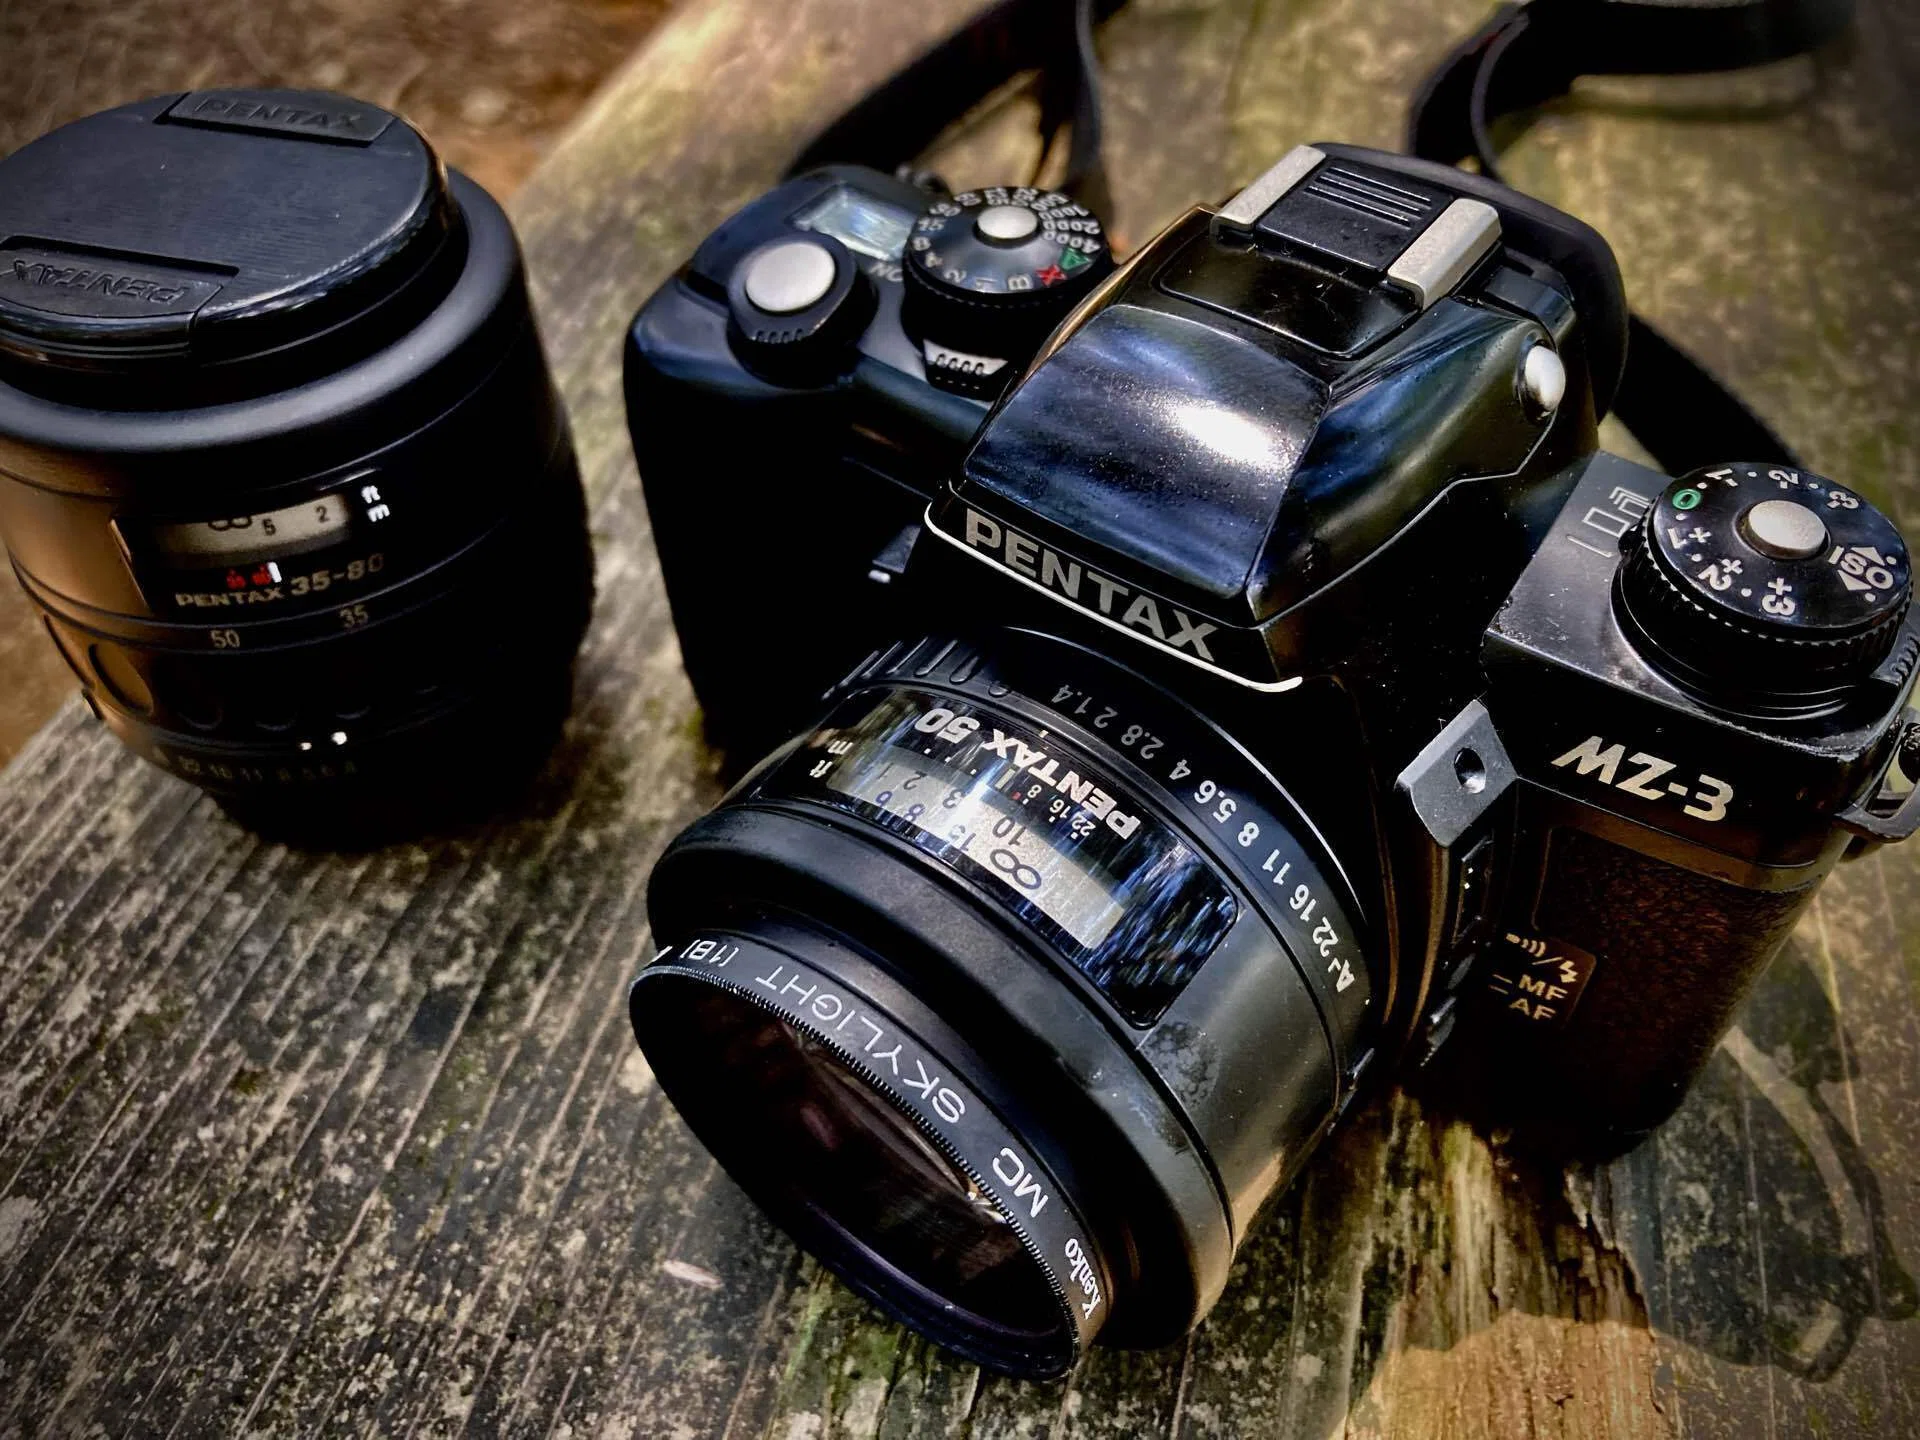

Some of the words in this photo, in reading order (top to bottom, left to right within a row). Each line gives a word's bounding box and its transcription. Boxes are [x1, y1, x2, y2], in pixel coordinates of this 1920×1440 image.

[194, 99, 363, 130] PENTAX
[1038, 204, 1090, 220] 1000
[1043, 220, 1100, 235] 2000
[1043, 230, 1100, 254] 4000
[13, 259, 190, 304] PENTAX
[1008, 275, 1033, 291] B
[1035, 264, 1067, 287] X
[1672, 488, 1703, 510] 0
[261, 519, 277, 536] 5
[316, 506, 330, 524] 2
[175, 586, 284, 607] PENTAX
[290, 553, 384, 597] 35-80
[1828, 545, 1894, 590] ISO
[966, 507, 1218, 662] PENTAX
[211, 630, 240, 650] 50
[339, 605, 369, 629] 35
[1052, 684, 1093, 715] 1.4
[914, 707, 981, 744] 50
[1094, 706, 1118, 729] 2
[827, 739, 854, 755] m
[1121, 724, 1164, 759] 2.8
[809, 759, 833, 779] ft
[903, 771, 927, 790] 2
[1169, 759, 1191, 780] 4
[1551, 735, 1734, 821] MZ-3
[875, 790, 894, 807] 6
[981, 728, 1142, 840] PENTAX
[1028, 784, 1042, 798] 8
[905, 802, 925, 824] 8
[942, 788, 966, 810] 3
[1050, 799, 1071, 819] 16
[1194, 780, 1237, 824] 5.6
[950, 823, 978, 852] 15
[992, 814, 1028, 847] 10
[1071, 811, 1096, 838] 22
[1237, 822, 1260, 847] 8
[1262, 849, 1291, 885] 11
[1289, 883, 1317, 922] 16
[1312, 916, 1340, 957] 22
[1518, 974, 1568, 1001] MF
[1509, 998, 1557, 1020] AF
[755, 965, 966, 1124] SKYLIGHT
[991, 1147, 1049, 1218] MC
[1065, 1238, 1101, 1320] Kenko
